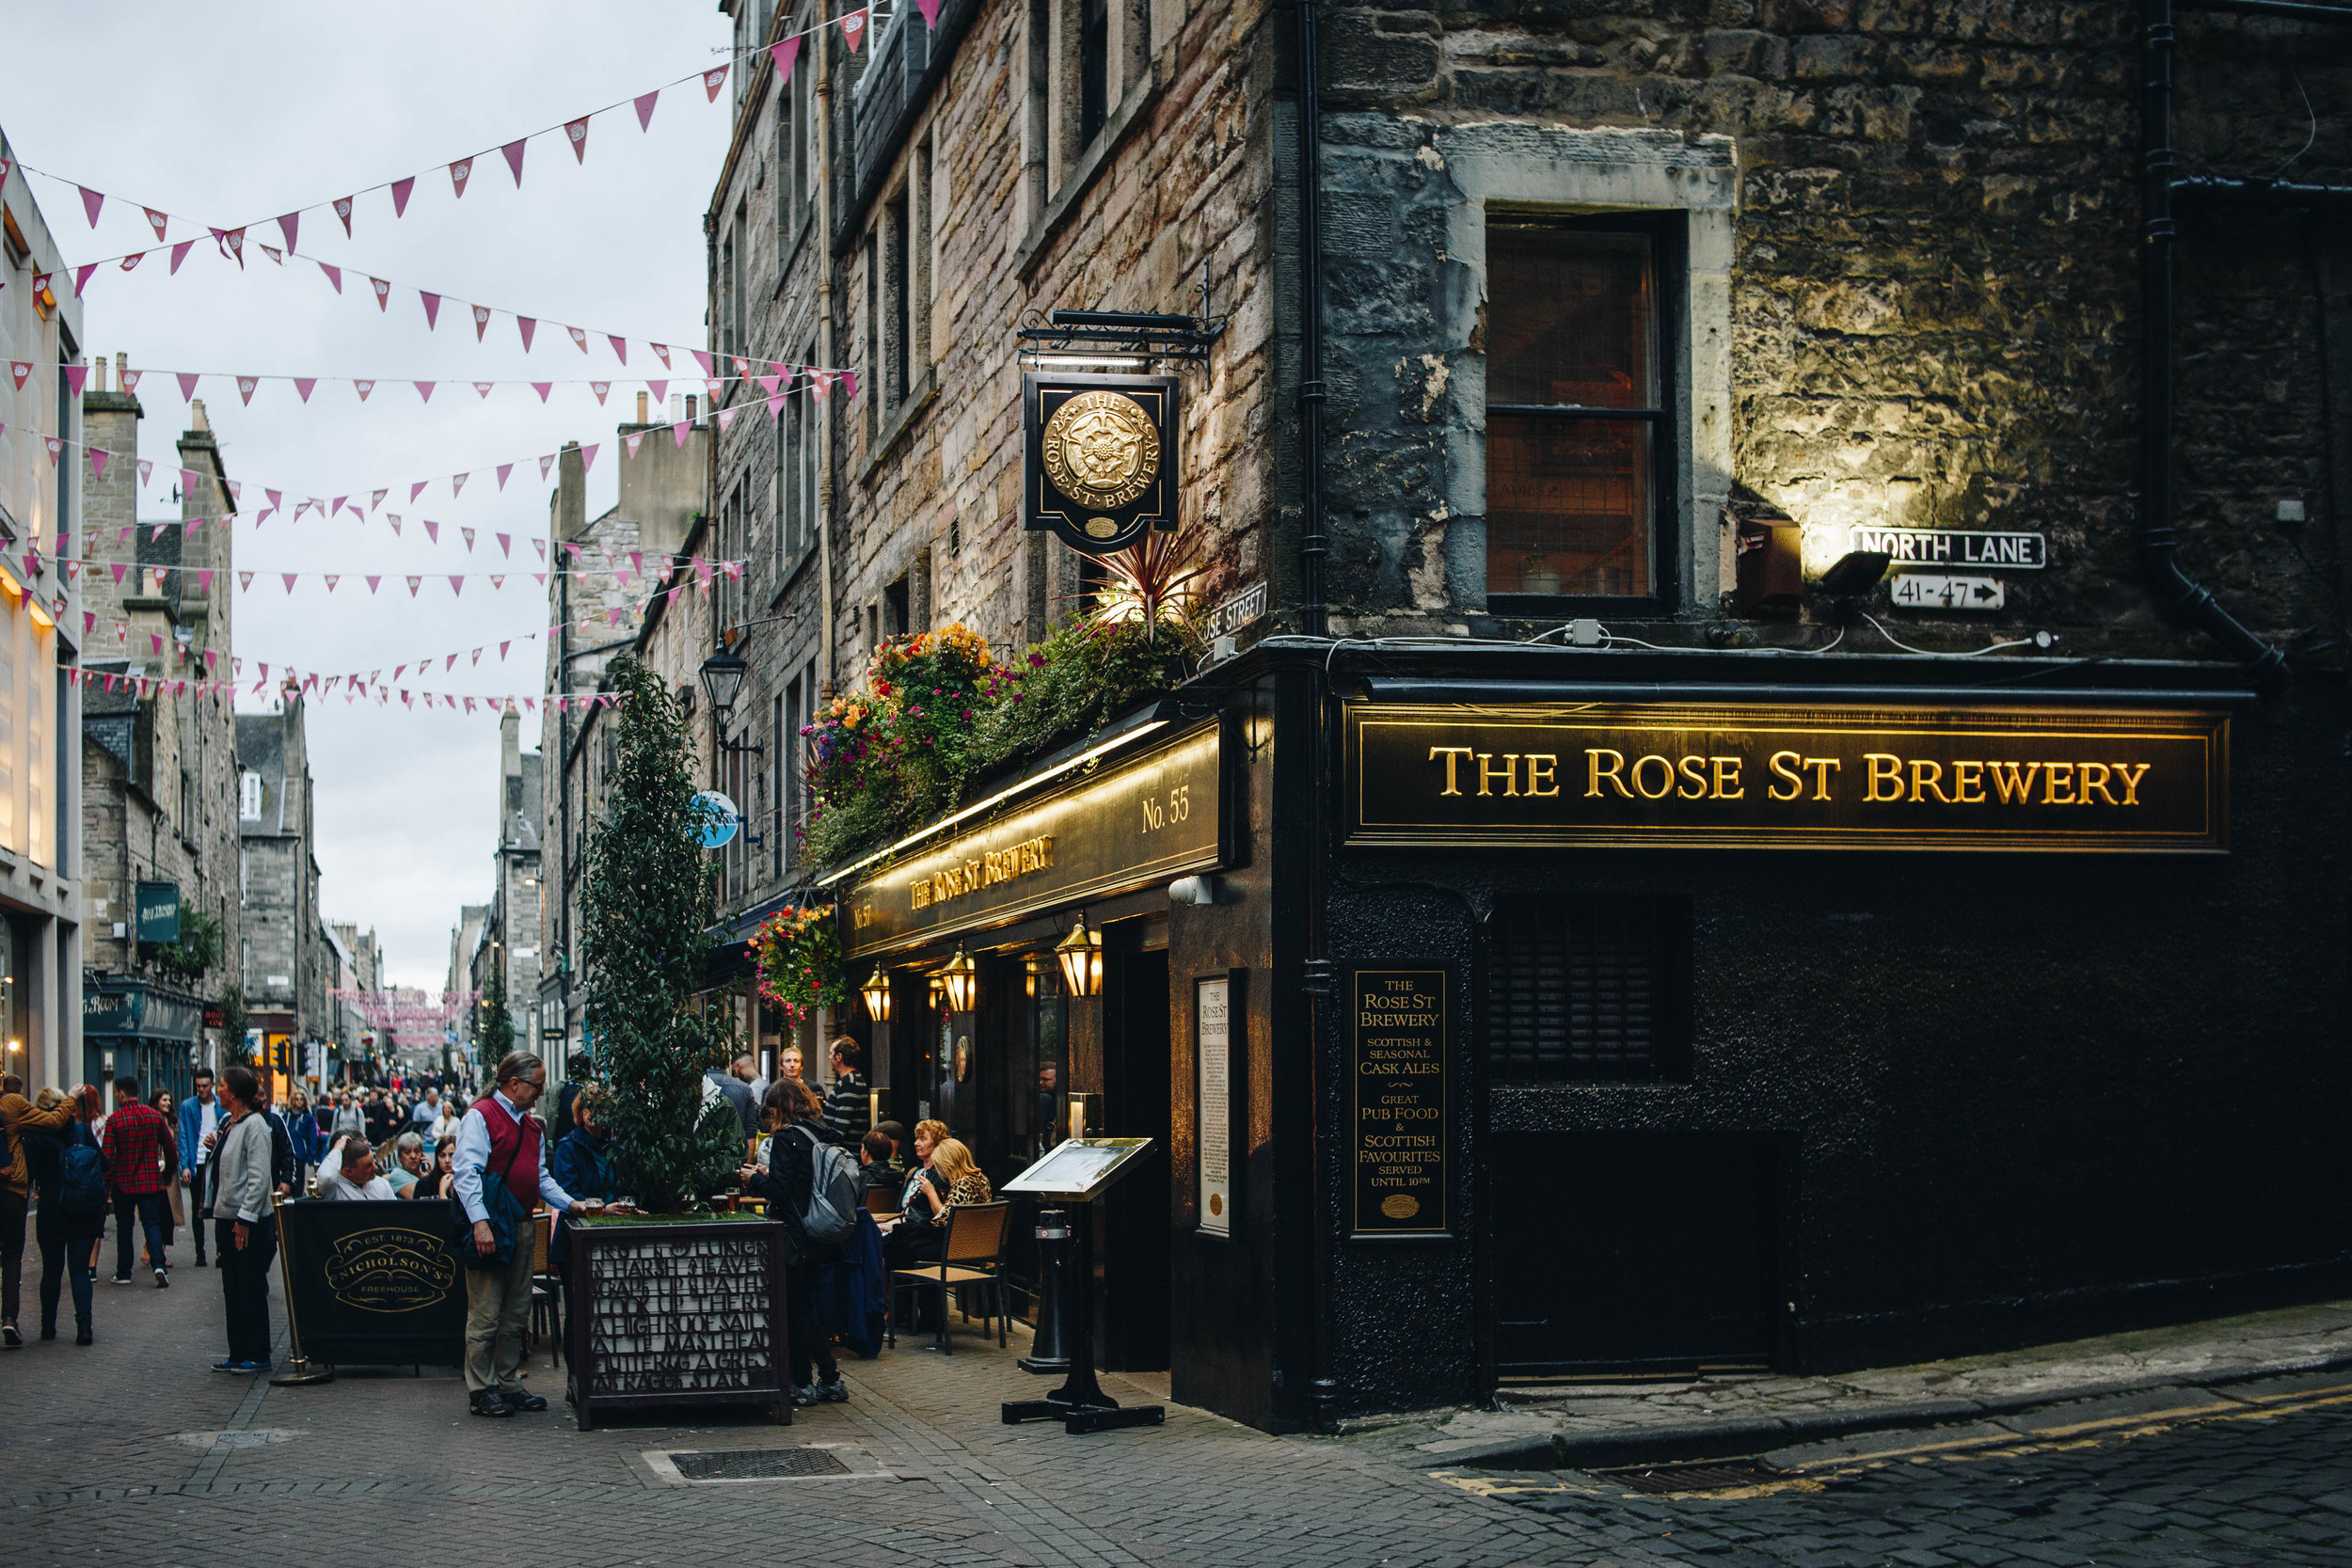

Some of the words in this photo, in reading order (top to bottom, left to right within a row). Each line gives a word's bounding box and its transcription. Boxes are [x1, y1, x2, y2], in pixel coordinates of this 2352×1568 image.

[1082, 394, 1120, 411] THE
[1046, 438, 1070, 486] ROSE
[1070, 486, 1095, 505] ST
[1104, 440, 1159, 508] BREWERY
[1861, 532, 1950, 561] NORTH
[1964, 536, 2032, 563] LANE
[1204, 611, 1221, 641] OSE
[1226, 590, 1262, 631] STREET
[1429, 747, 1560, 797] THE
[1584, 749, 1745, 800] ROSE
[1768, 751, 1841, 801] ST
[1862, 753, 2152, 806] BREWERY
[1142, 797, 1166, 834] No.
[1169, 784, 1189, 824] 55
[910, 879, 930, 911] THE
[934, 867, 961, 902] ROSE
[964, 859, 979, 893] ST
[985, 835, 1055, 885] BREWERY
[1385, 981, 1414, 991] THE
[1210, 991, 1220, 1001] THE
[1364, 993, 1409, 1009] ROSE
[1412, 993, 1436, 1009] ST
[1203, 1005, 1218, 1019] ROSE
[1219, 1004, 1227, 1017] ST
[1360, 1011, 1439, 1027] BREWERY
[1201, 1022, 1228, 1036] BREWERY
[1367, 1037, 1421, 1047] SCOTTISH
[1424, 1037, 1433, 1047] &
[1370, 1050, 1430, 1059] SEASONAL
[1360, 1062, 1399, 1075] CASK
[1402, 1062, 1440, 1074] ALES
[1381, 1095, 1420, 1104] GREAT
[1361, 1107, 1391, 1120] PUB
[1394, 1107, 1438, 1119] FOOD
[1395, 1122, 1405, 1132] &
[1364, 1134, 1436, 1148] SCOTTISH
[1359, 1150, 1440, 1164] FAVOURITES
[1378, 1165, 1422, 1175] SERVED
[1371, 1178, 1406, 1187] UNTIL
[390, 1234, 414, 1244] 1873
[340, 1257, 443, 1280] NICHOLSON'S
